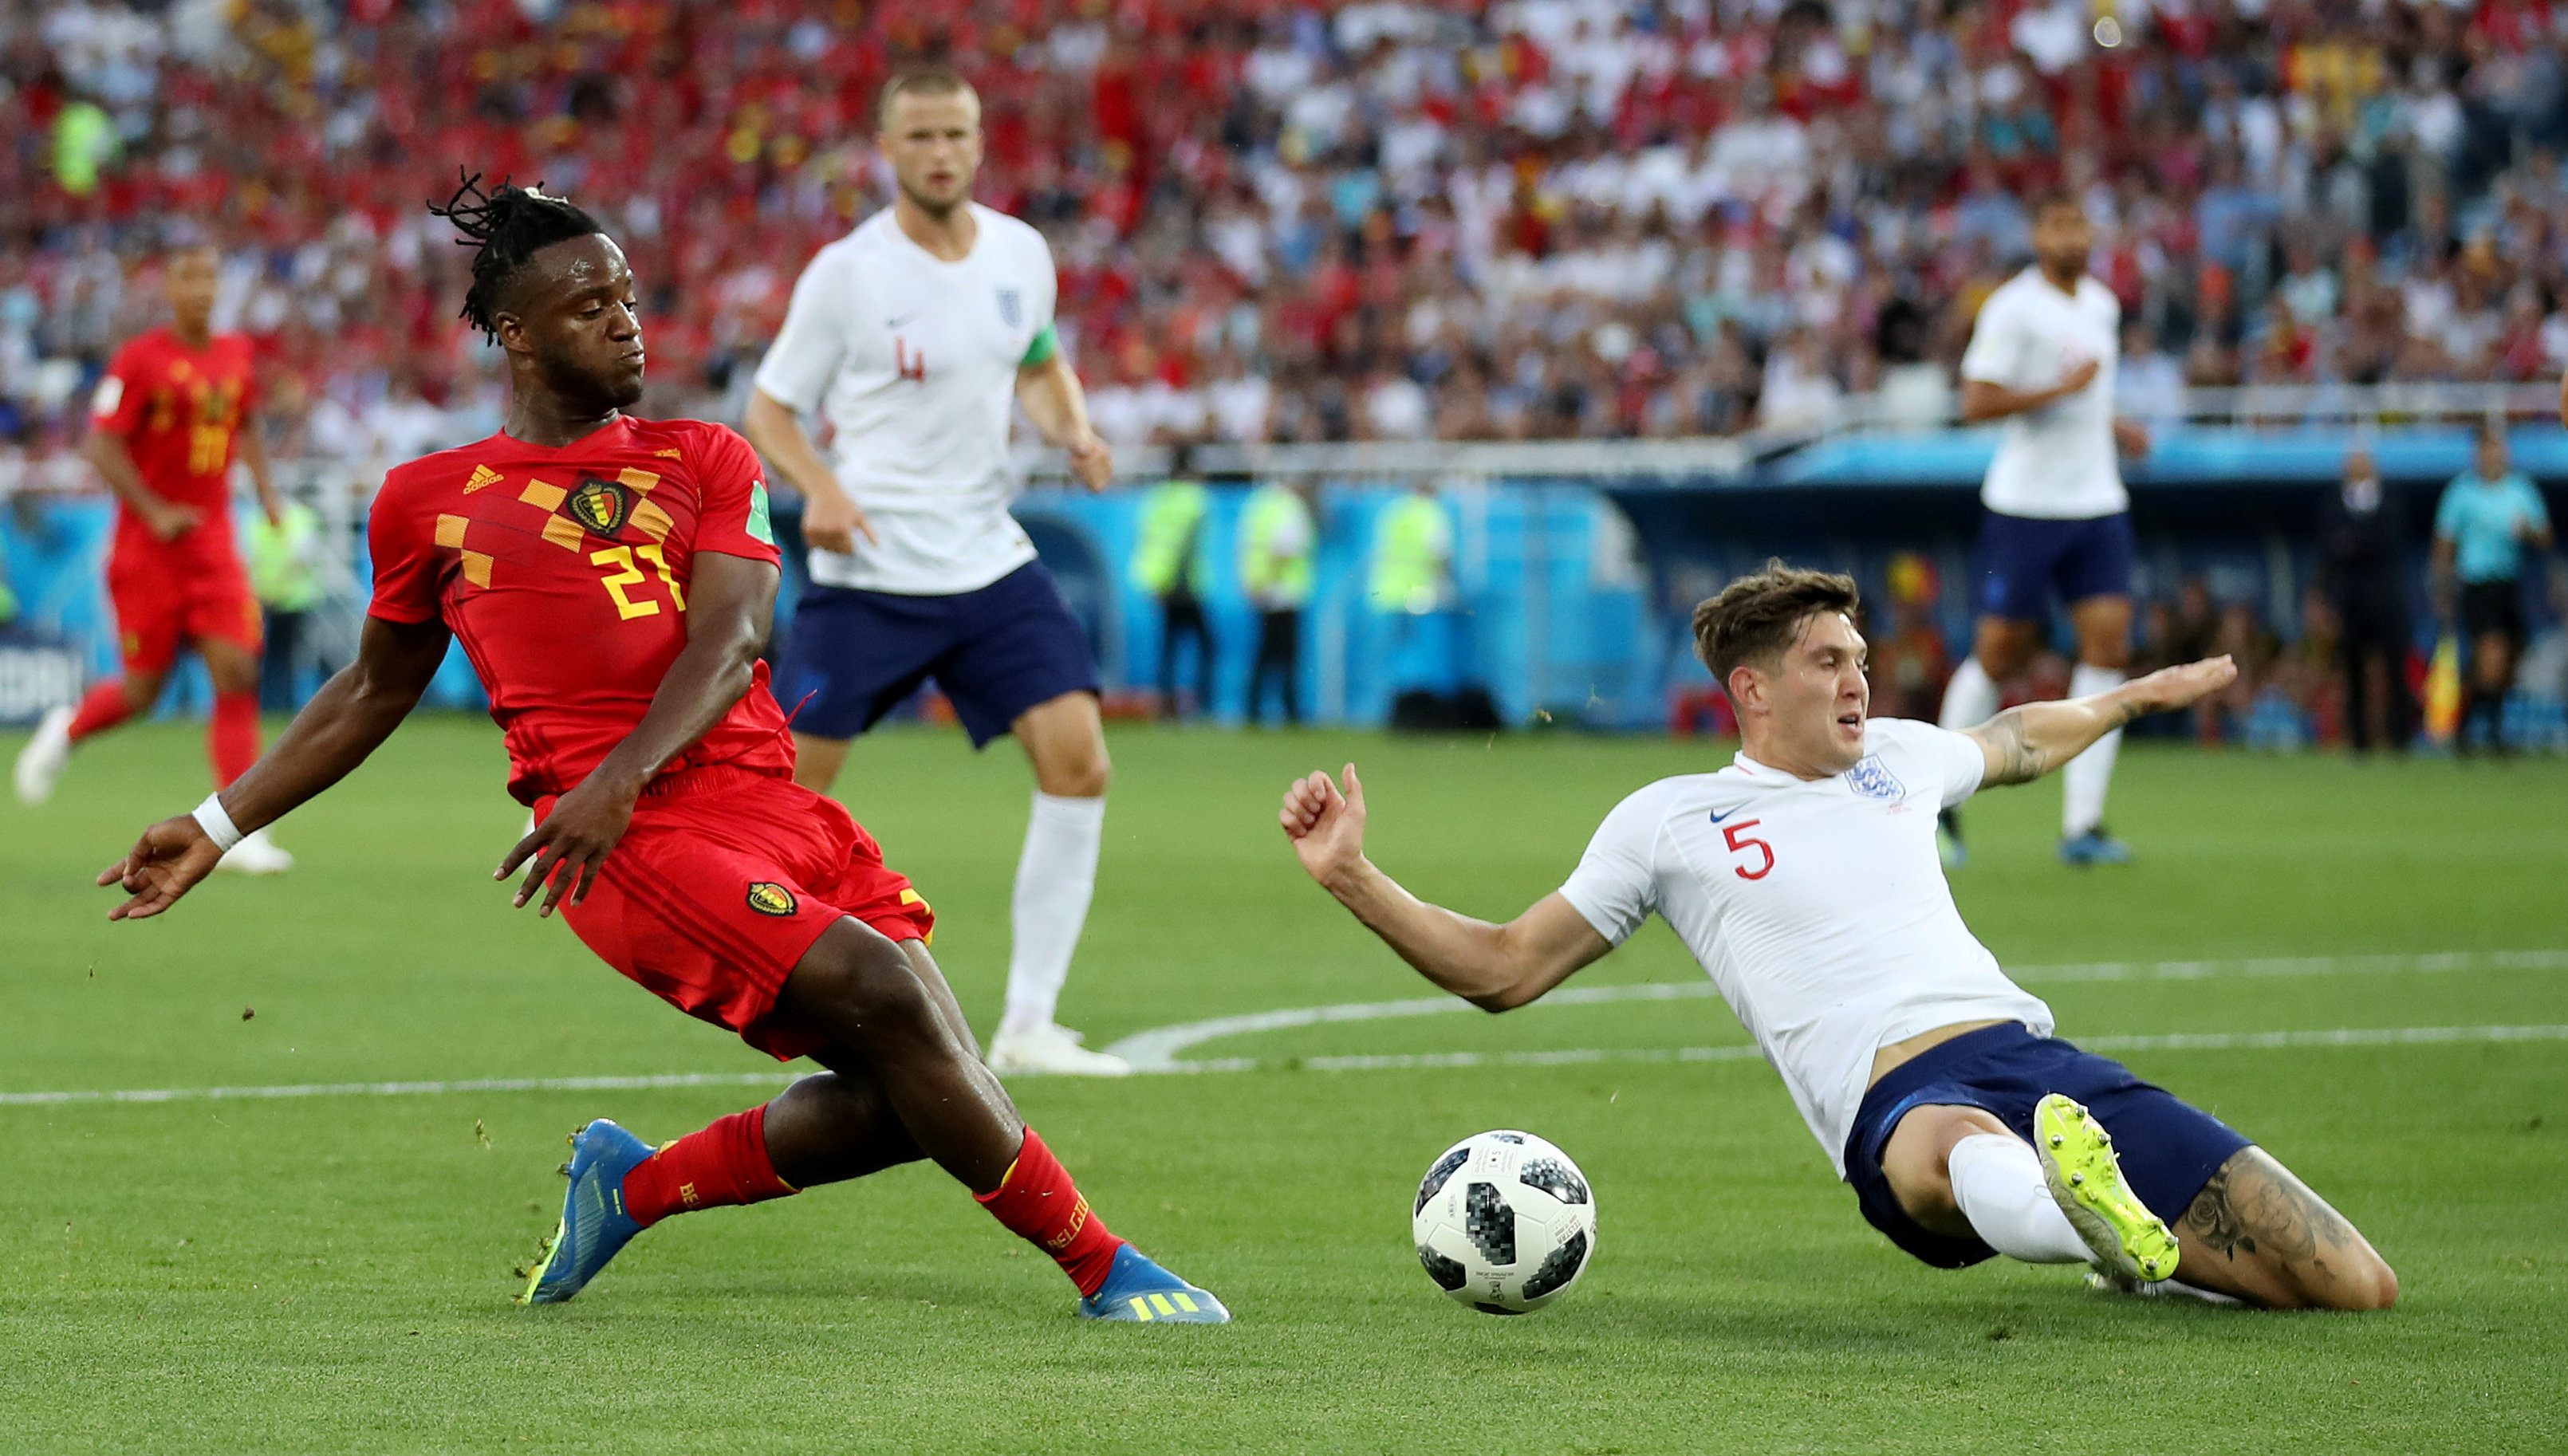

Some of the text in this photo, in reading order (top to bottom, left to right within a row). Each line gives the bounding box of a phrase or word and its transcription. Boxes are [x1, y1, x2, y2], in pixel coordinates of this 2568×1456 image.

[896, 336, 924, 384] 4
[463, 474, 504, 495] adidas
[589, 544, 686, 620] 21
[1723, 818, 1774, 880] 5
[1047, 1190, 1089, 1248] BELGIU
